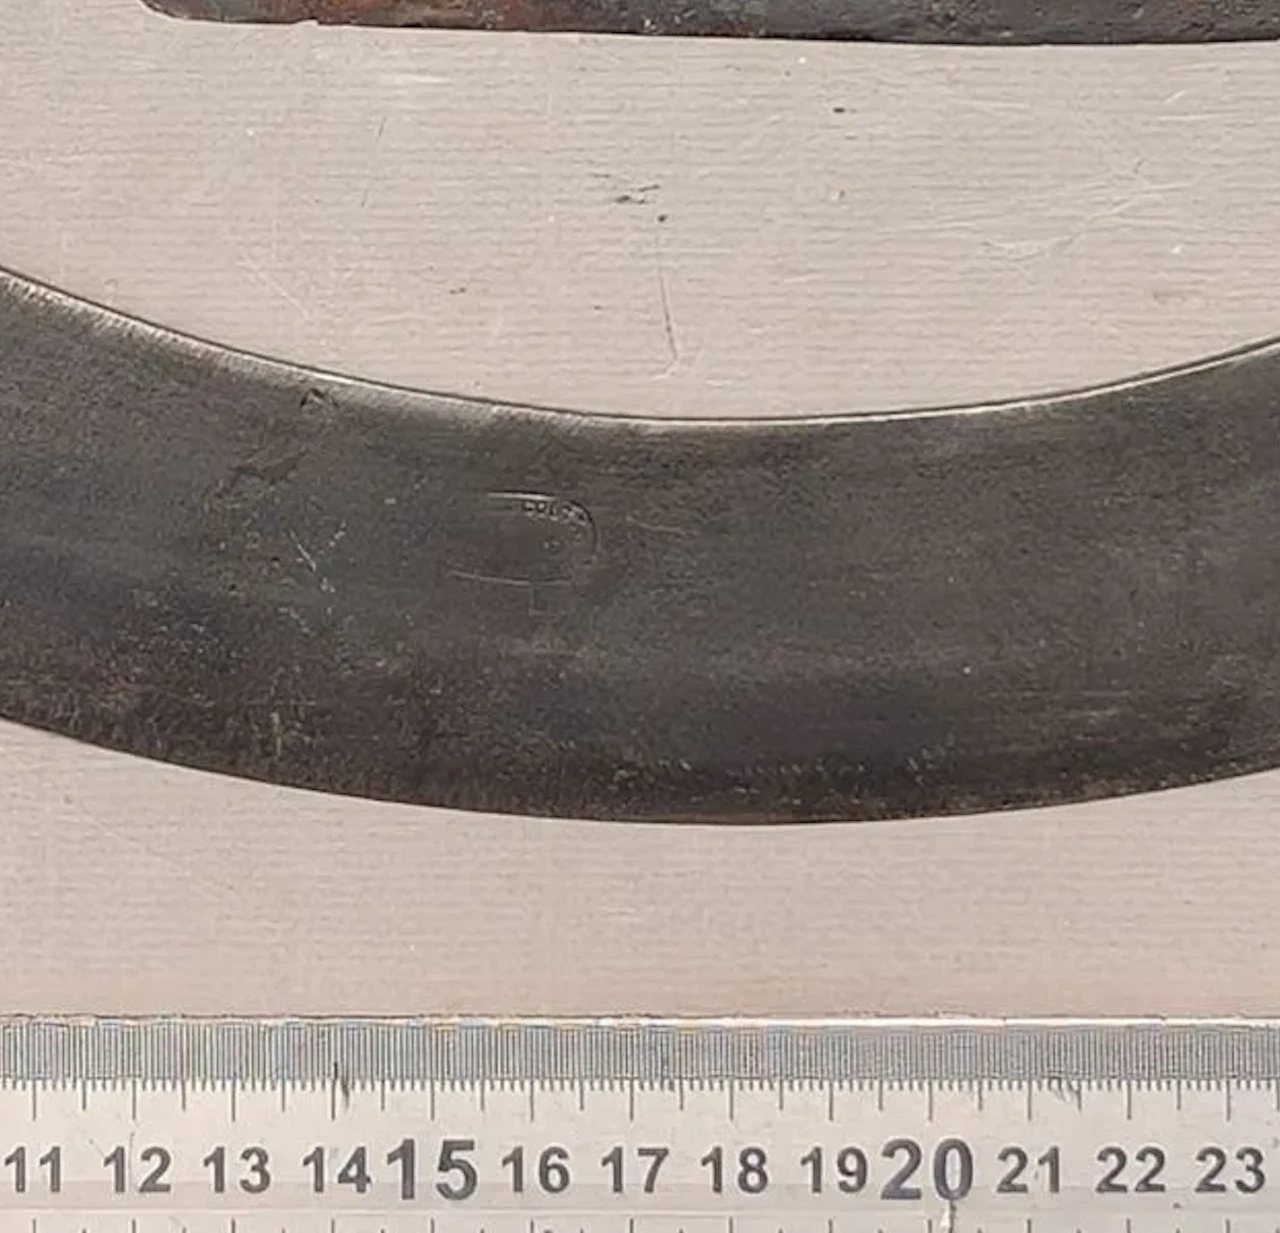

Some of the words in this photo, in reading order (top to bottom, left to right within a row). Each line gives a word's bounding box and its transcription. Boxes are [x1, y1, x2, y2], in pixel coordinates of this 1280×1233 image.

[5, 1146, 61, 1194] 11
[104, 1146, 171, 1194] 12
[204, 1146, 270, 1194] 13
[303, 1146, 372, 1194] 14
[387, 1139, 477, 1201] 15
[502, 1146, 570, 1194] 16
[601, 1147, 669, 1194] 17
[701, 1146, 768, 1194] 18
[800, 1147, 868, 1194] 19
[880, 1139, 973, 1201] 20
[997, 1146, 1060, 1194] 21
[1095, 1147, 1166, 1194] 22
[1195, 1147, 1265, 1194] 23
